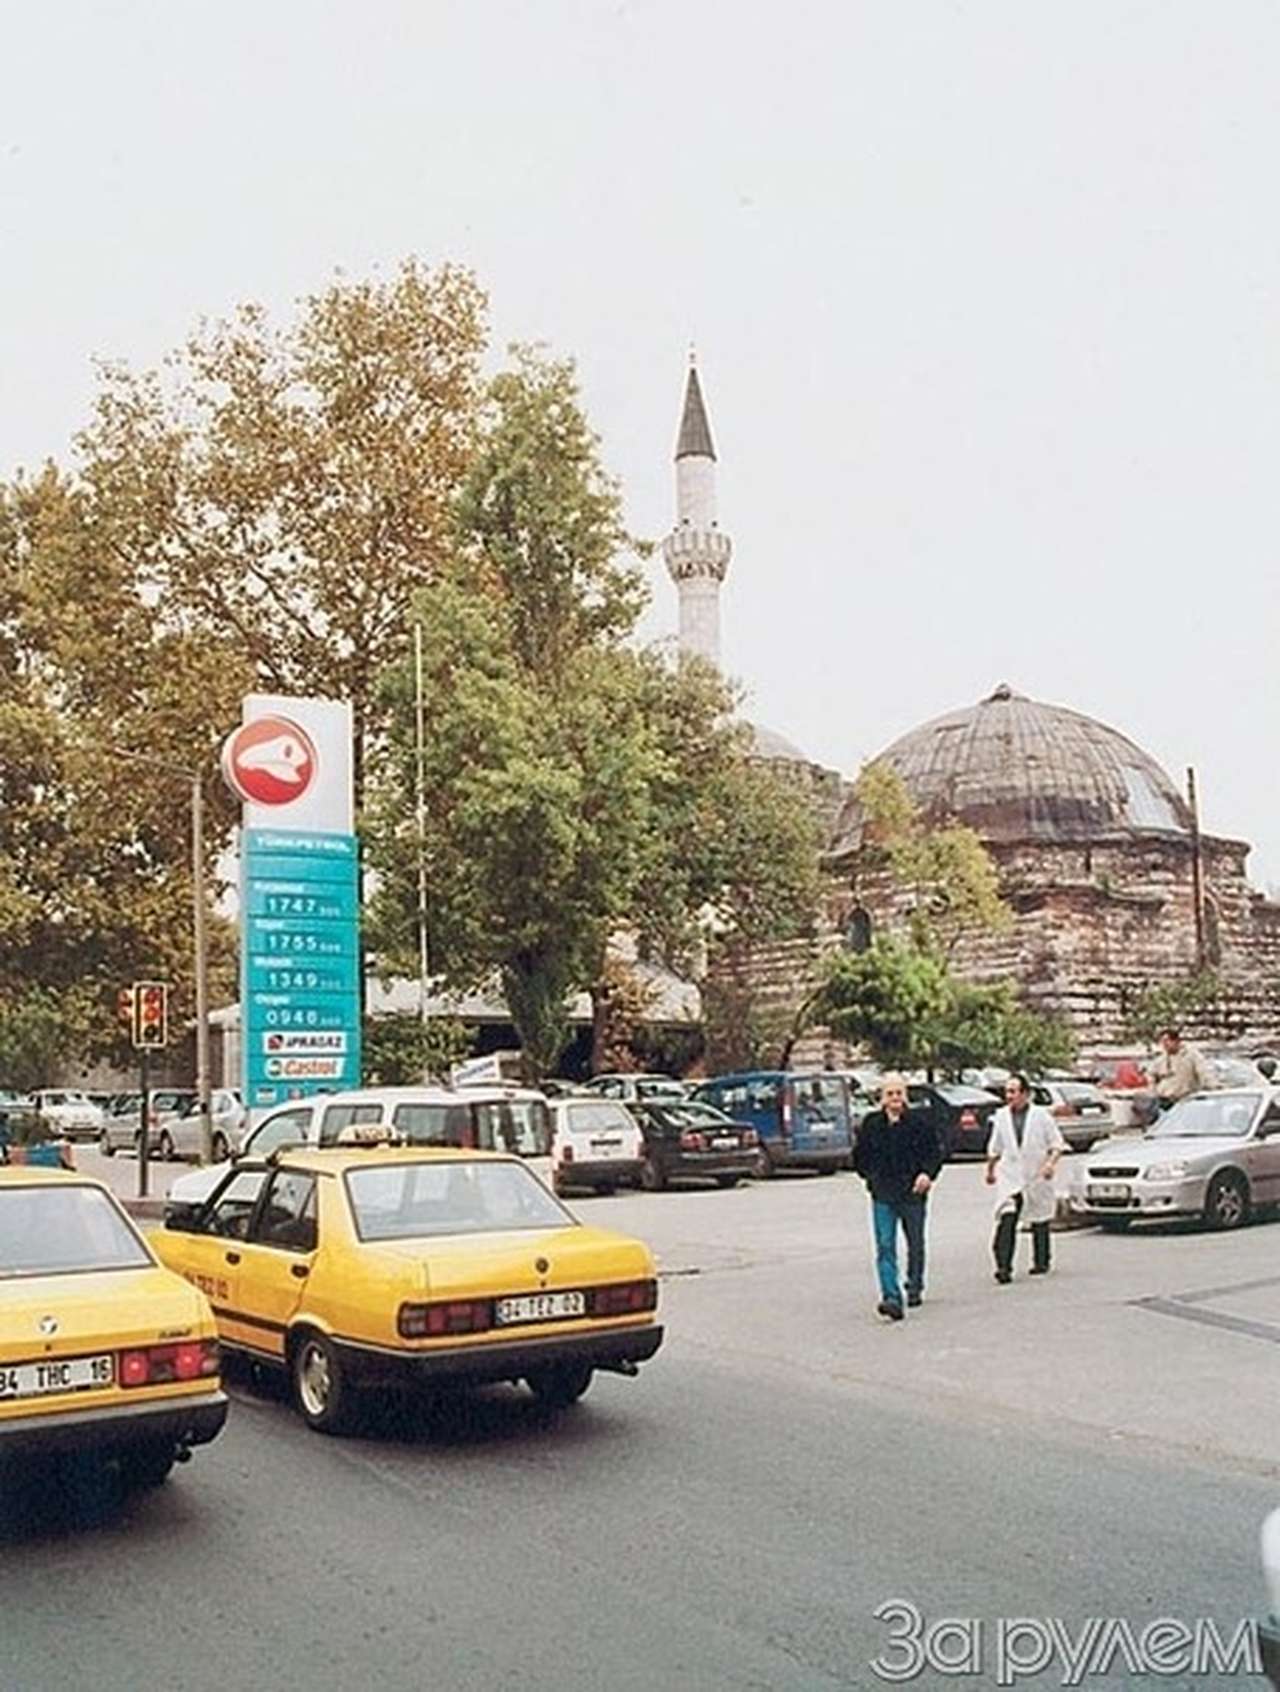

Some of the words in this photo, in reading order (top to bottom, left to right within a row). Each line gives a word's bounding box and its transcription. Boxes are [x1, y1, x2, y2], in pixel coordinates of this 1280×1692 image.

[268, 897, 316, 912] 1747
[268, 971, 318, 988] 1349
[284, 1058, 337, 1075] Castrol
